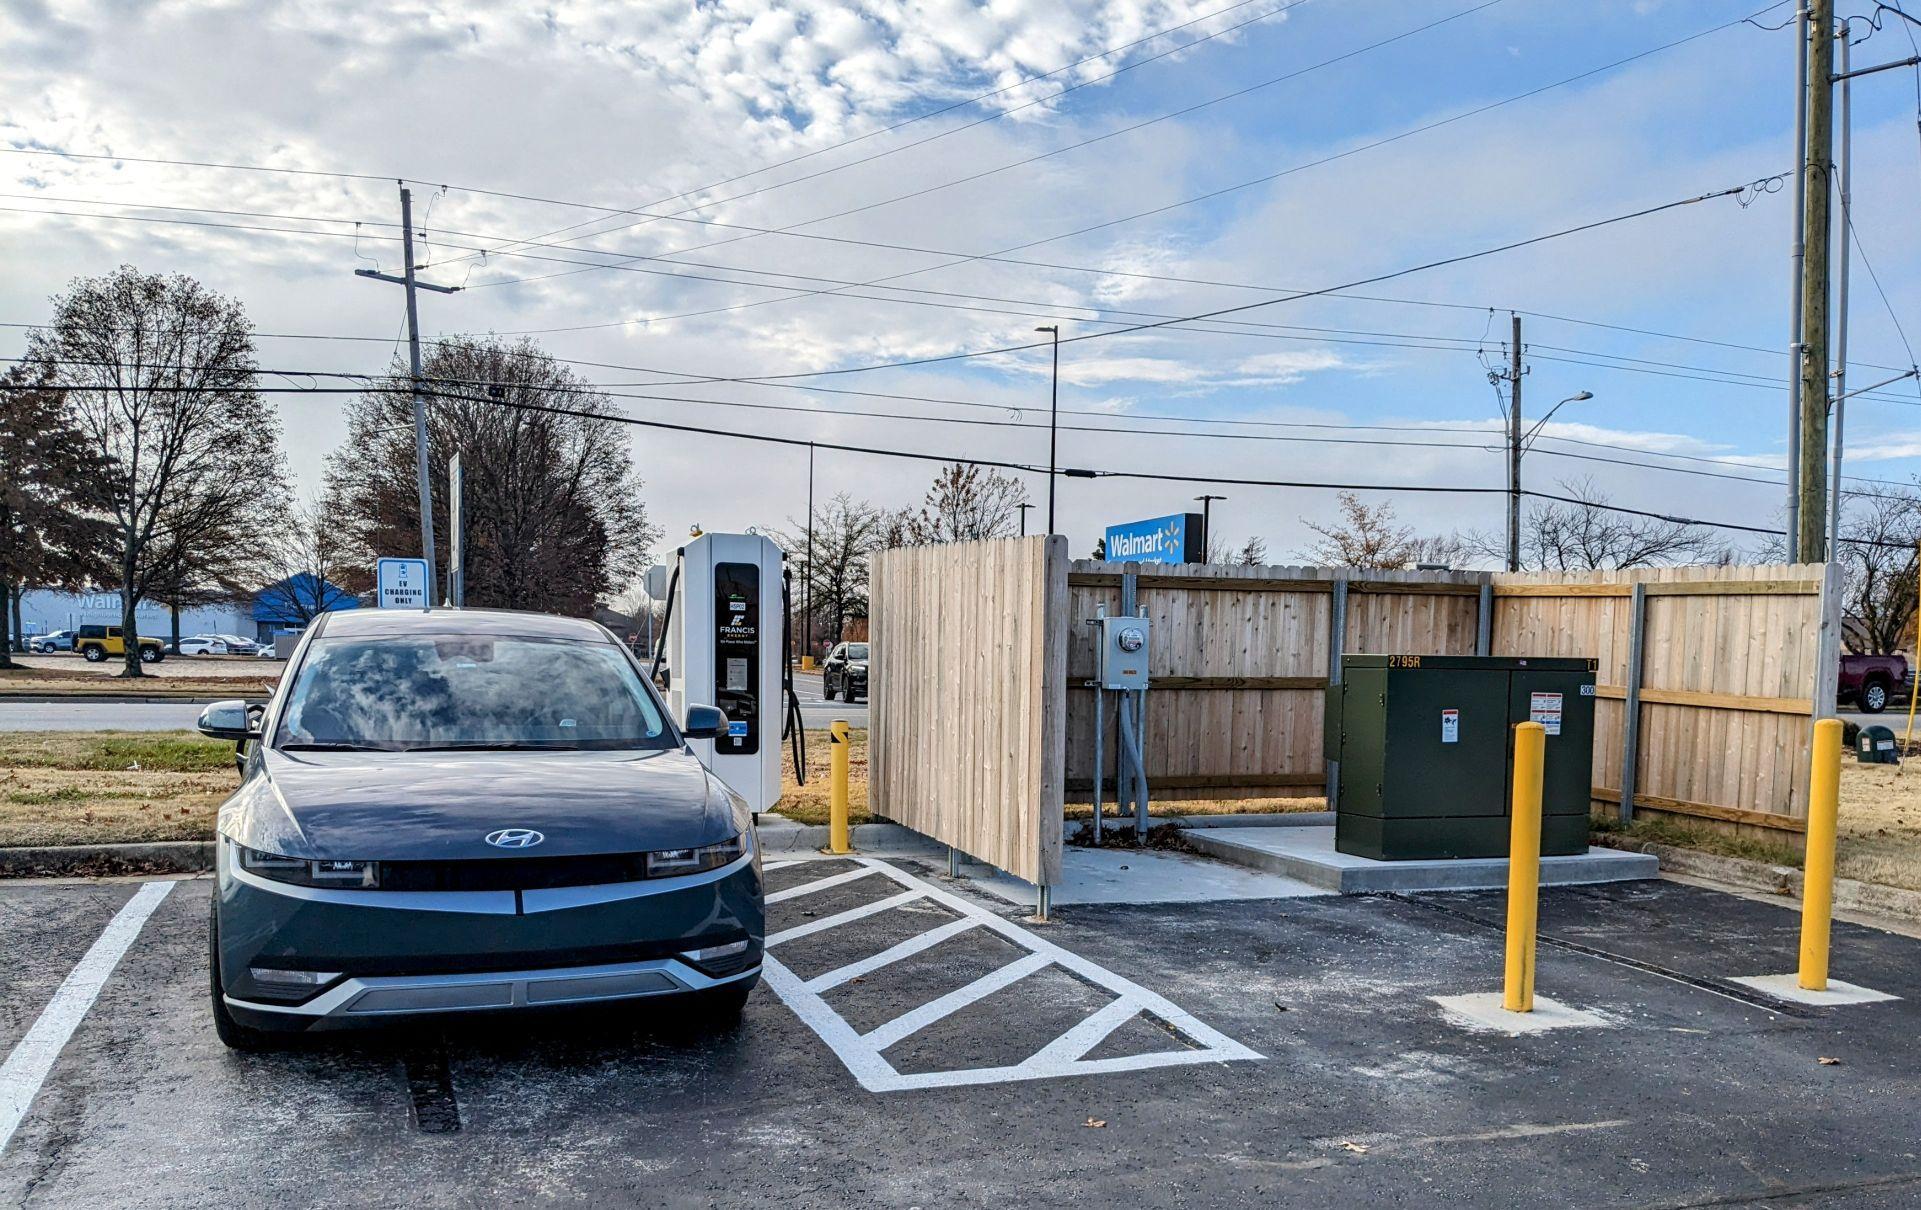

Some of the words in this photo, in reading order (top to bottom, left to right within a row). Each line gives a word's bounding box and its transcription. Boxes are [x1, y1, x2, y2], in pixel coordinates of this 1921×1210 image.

[1111, 528, 1162, 557] Walmart
[1389, 655, 1421, 668] 2795R
[1581, 685, 1595, 694] 300
